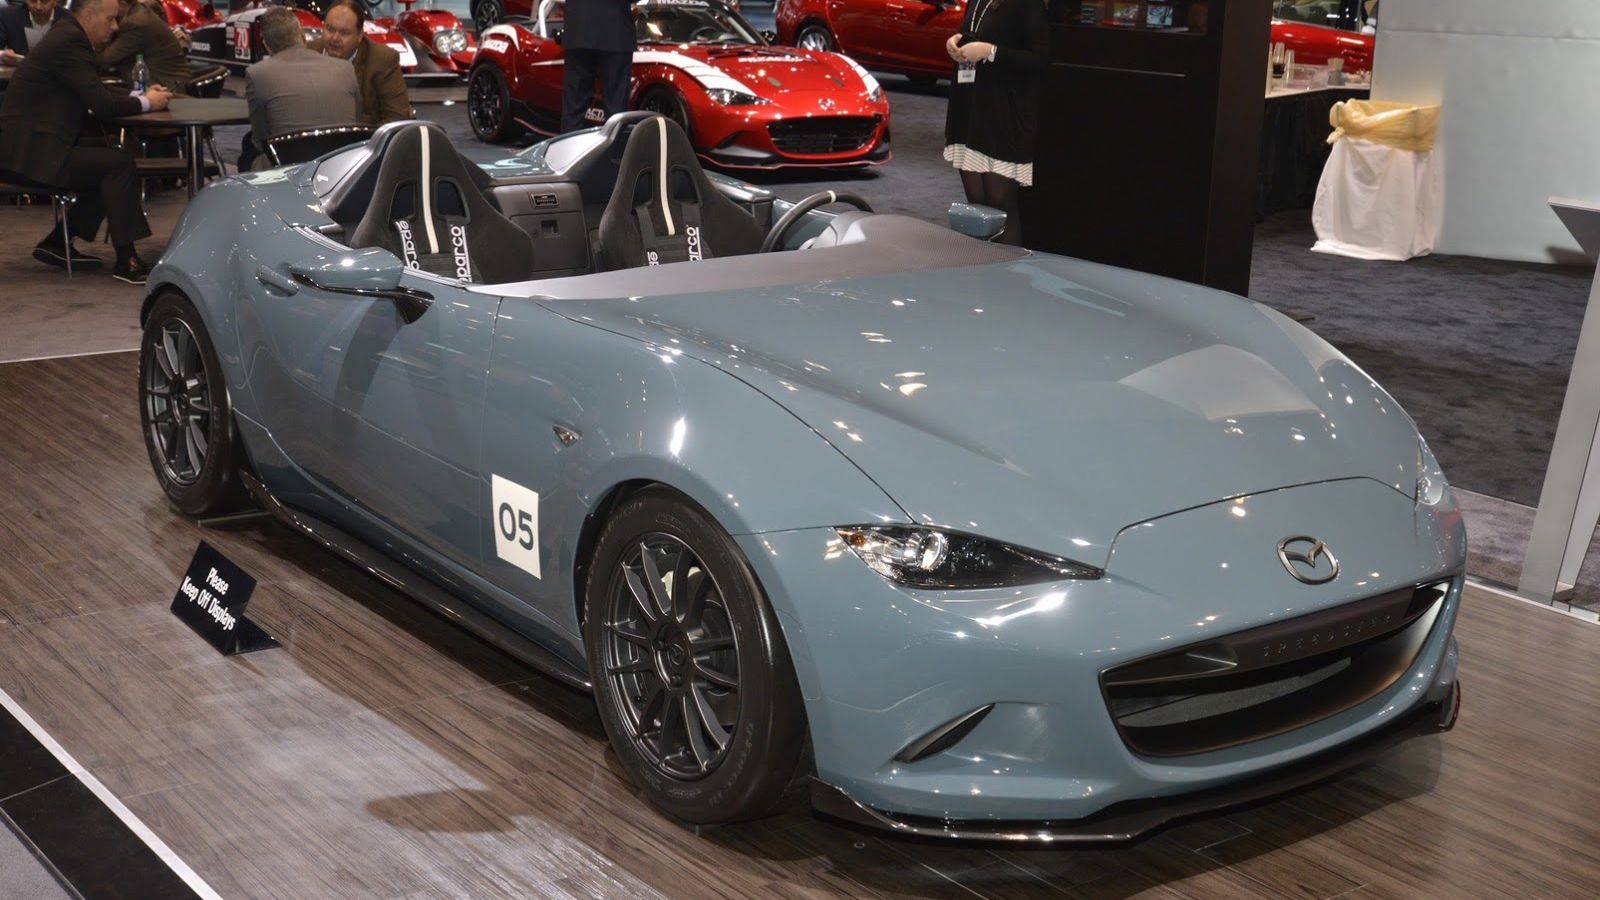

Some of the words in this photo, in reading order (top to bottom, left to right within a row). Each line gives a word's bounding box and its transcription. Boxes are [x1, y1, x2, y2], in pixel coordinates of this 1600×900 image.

[236, 28, 248, 48] 70
[499, 502, 534, 551] 05
[206, 567, 229, 595] Please
[181, 576, 199, 602] Keep
[197, 589, 213, 609] Off
[207, 597, 236, 631] Displays
